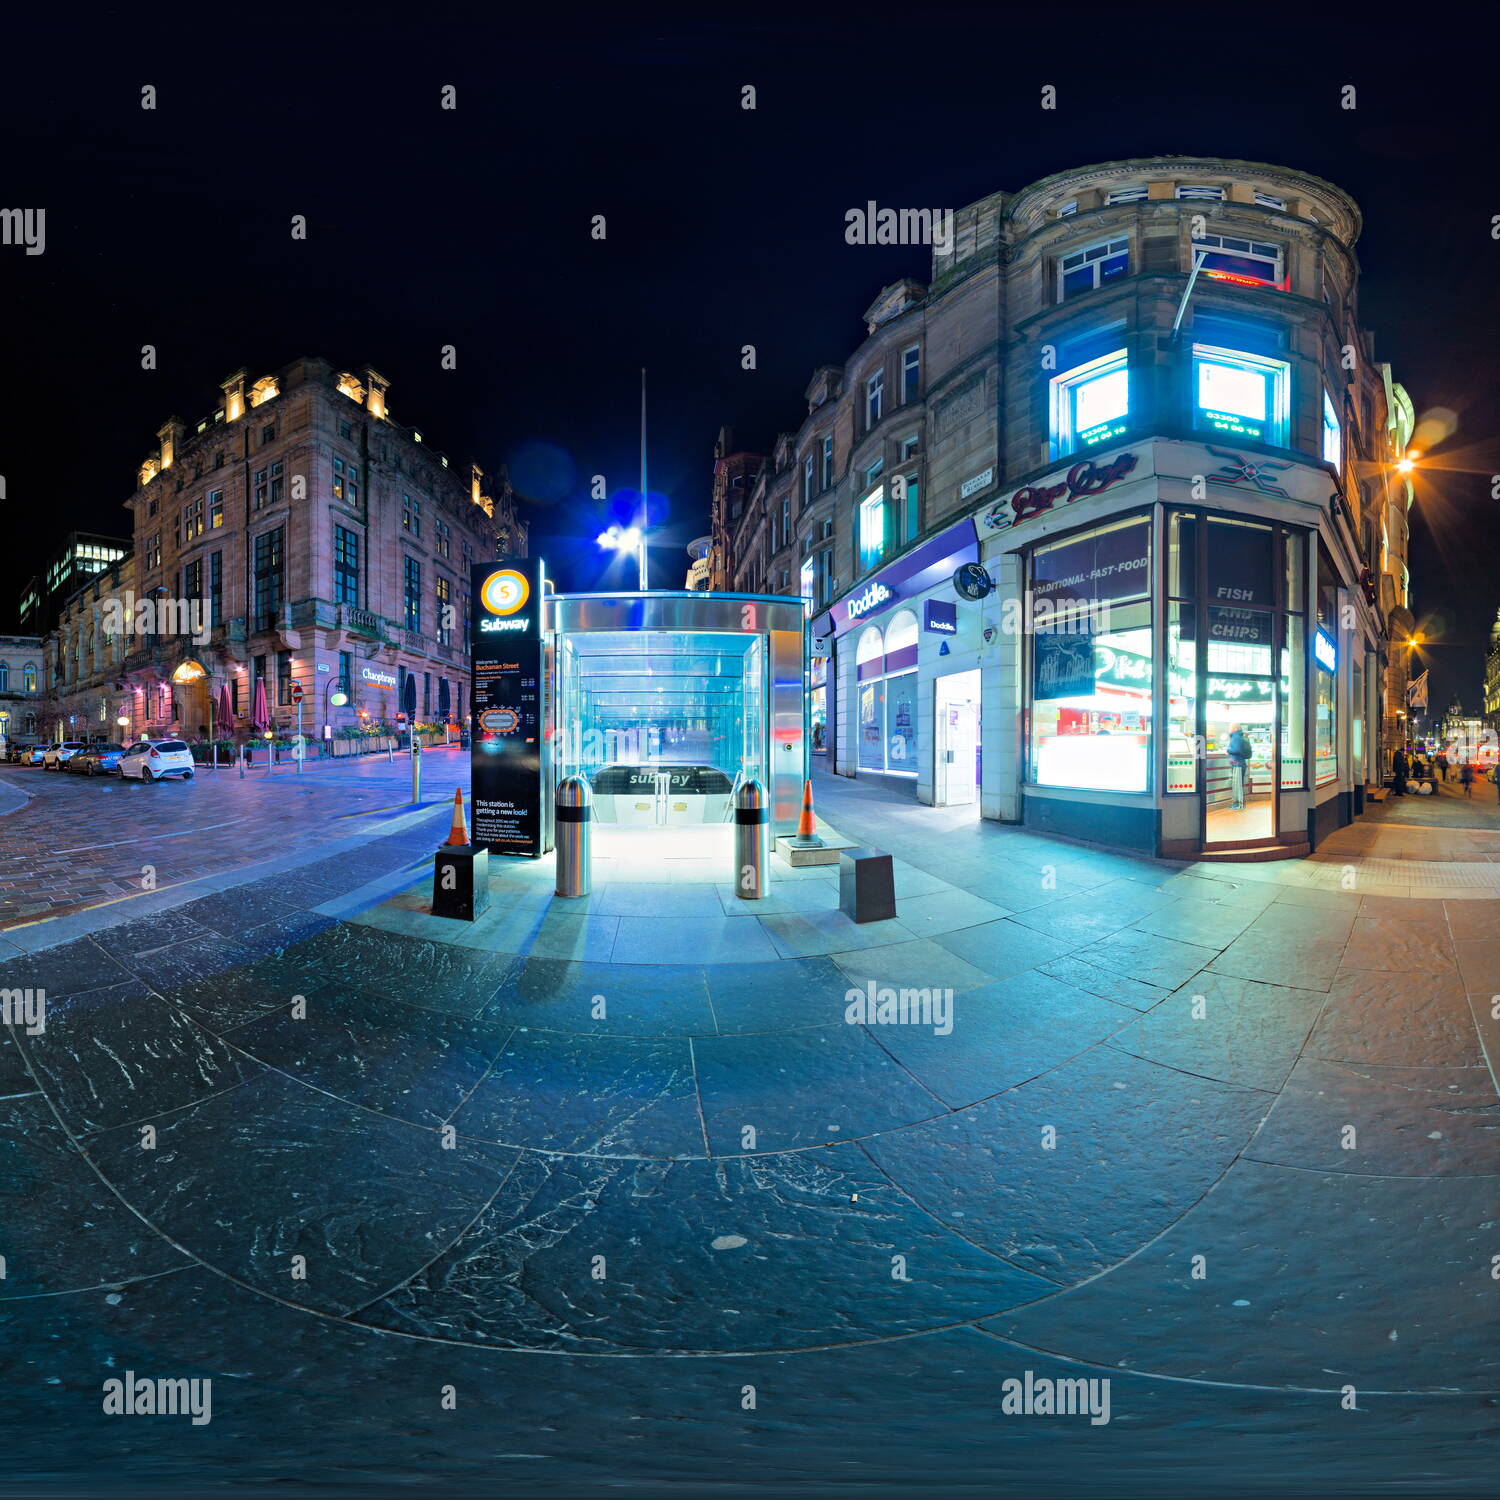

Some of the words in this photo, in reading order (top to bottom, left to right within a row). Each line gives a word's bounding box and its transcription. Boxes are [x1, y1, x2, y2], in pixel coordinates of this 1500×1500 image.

[1206, 412, 1240, 423] 03300
[1082, 424, 1109, 439] 03300
[1087, 436, 1100, 445] 04
[1100, 431, 1112, 440] 00
[1113, 426, 1127, 435] 10
[1214, 421, 1229, 430] 04
[1231, 425, 1245, 433] 00
[1246, 428, 1260, 437] 10
[500, 585, 510, 599] S
[1217, 587, 1254, 601] FISH
[1217, 608, 1253, 621] AND
[480, 617, 530, 632] Subway
[1212, 623, 1260, 640] CHIPS
[362, 667, 397, 687] Chaophraya
[476, 808, 496, 816] getting
[513, 808, 528, 816] look!
